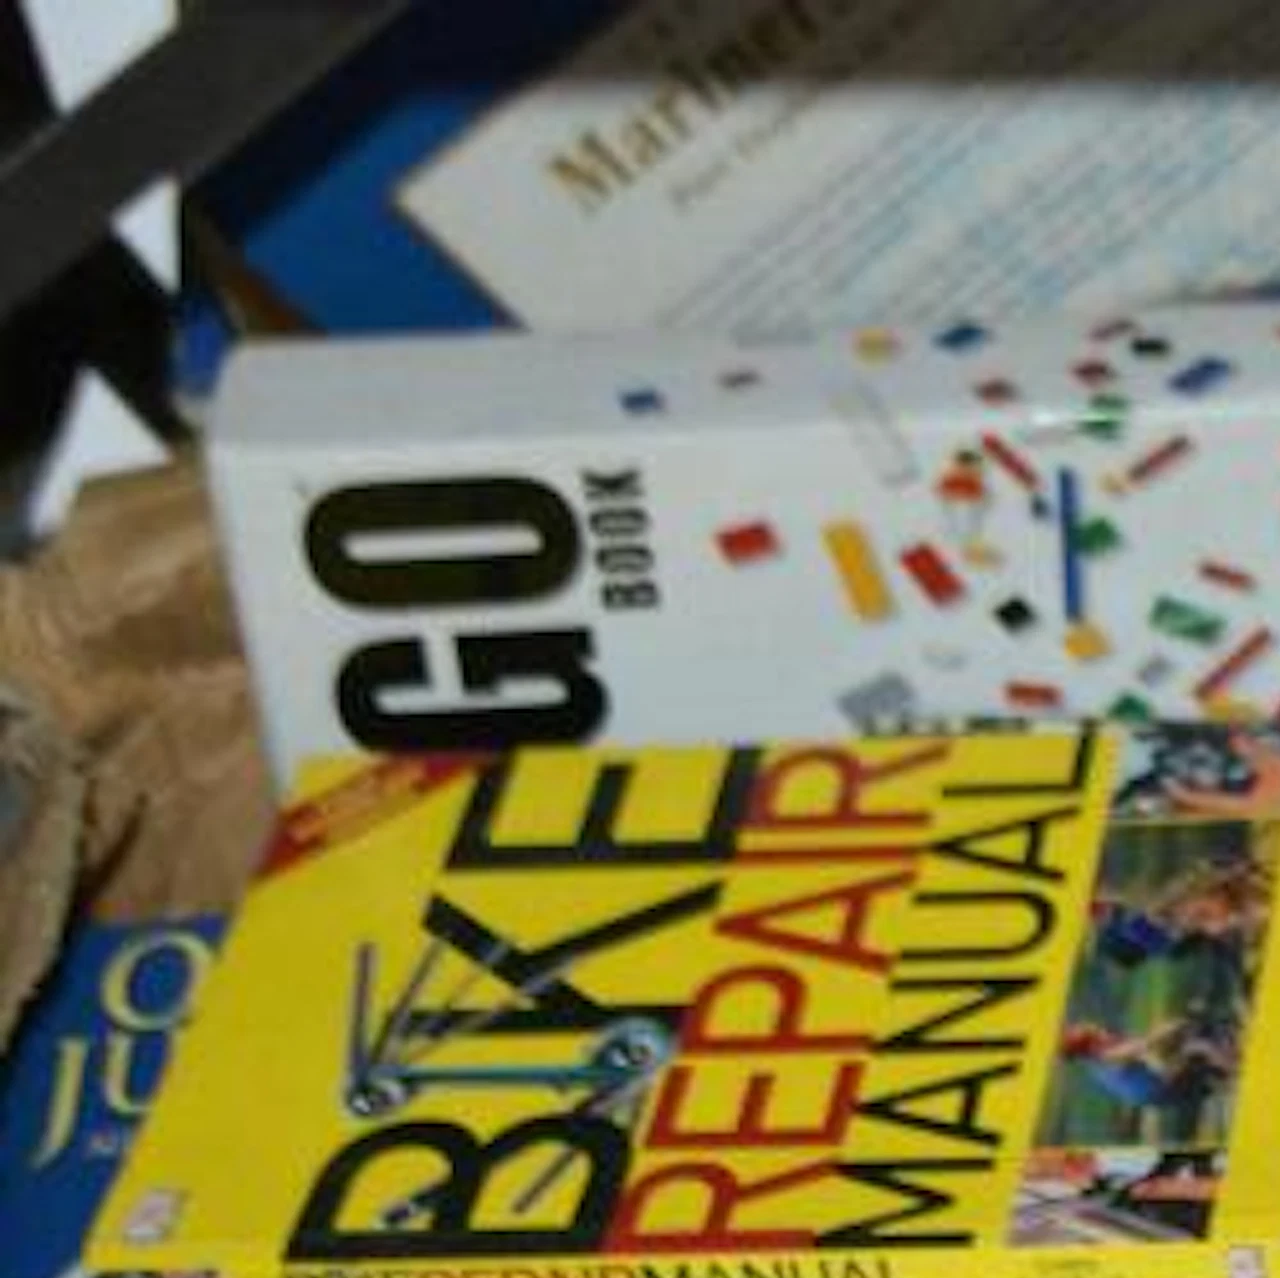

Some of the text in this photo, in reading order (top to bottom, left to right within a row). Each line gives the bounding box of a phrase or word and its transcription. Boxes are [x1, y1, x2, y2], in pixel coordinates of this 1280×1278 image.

[582, 468, 662, 610] BOOK
[281, 746, 768, 1262] BIKE
[604, 741, 952, 1256] REPAIR
[813, 720, 1099, 1251] MANUAL
